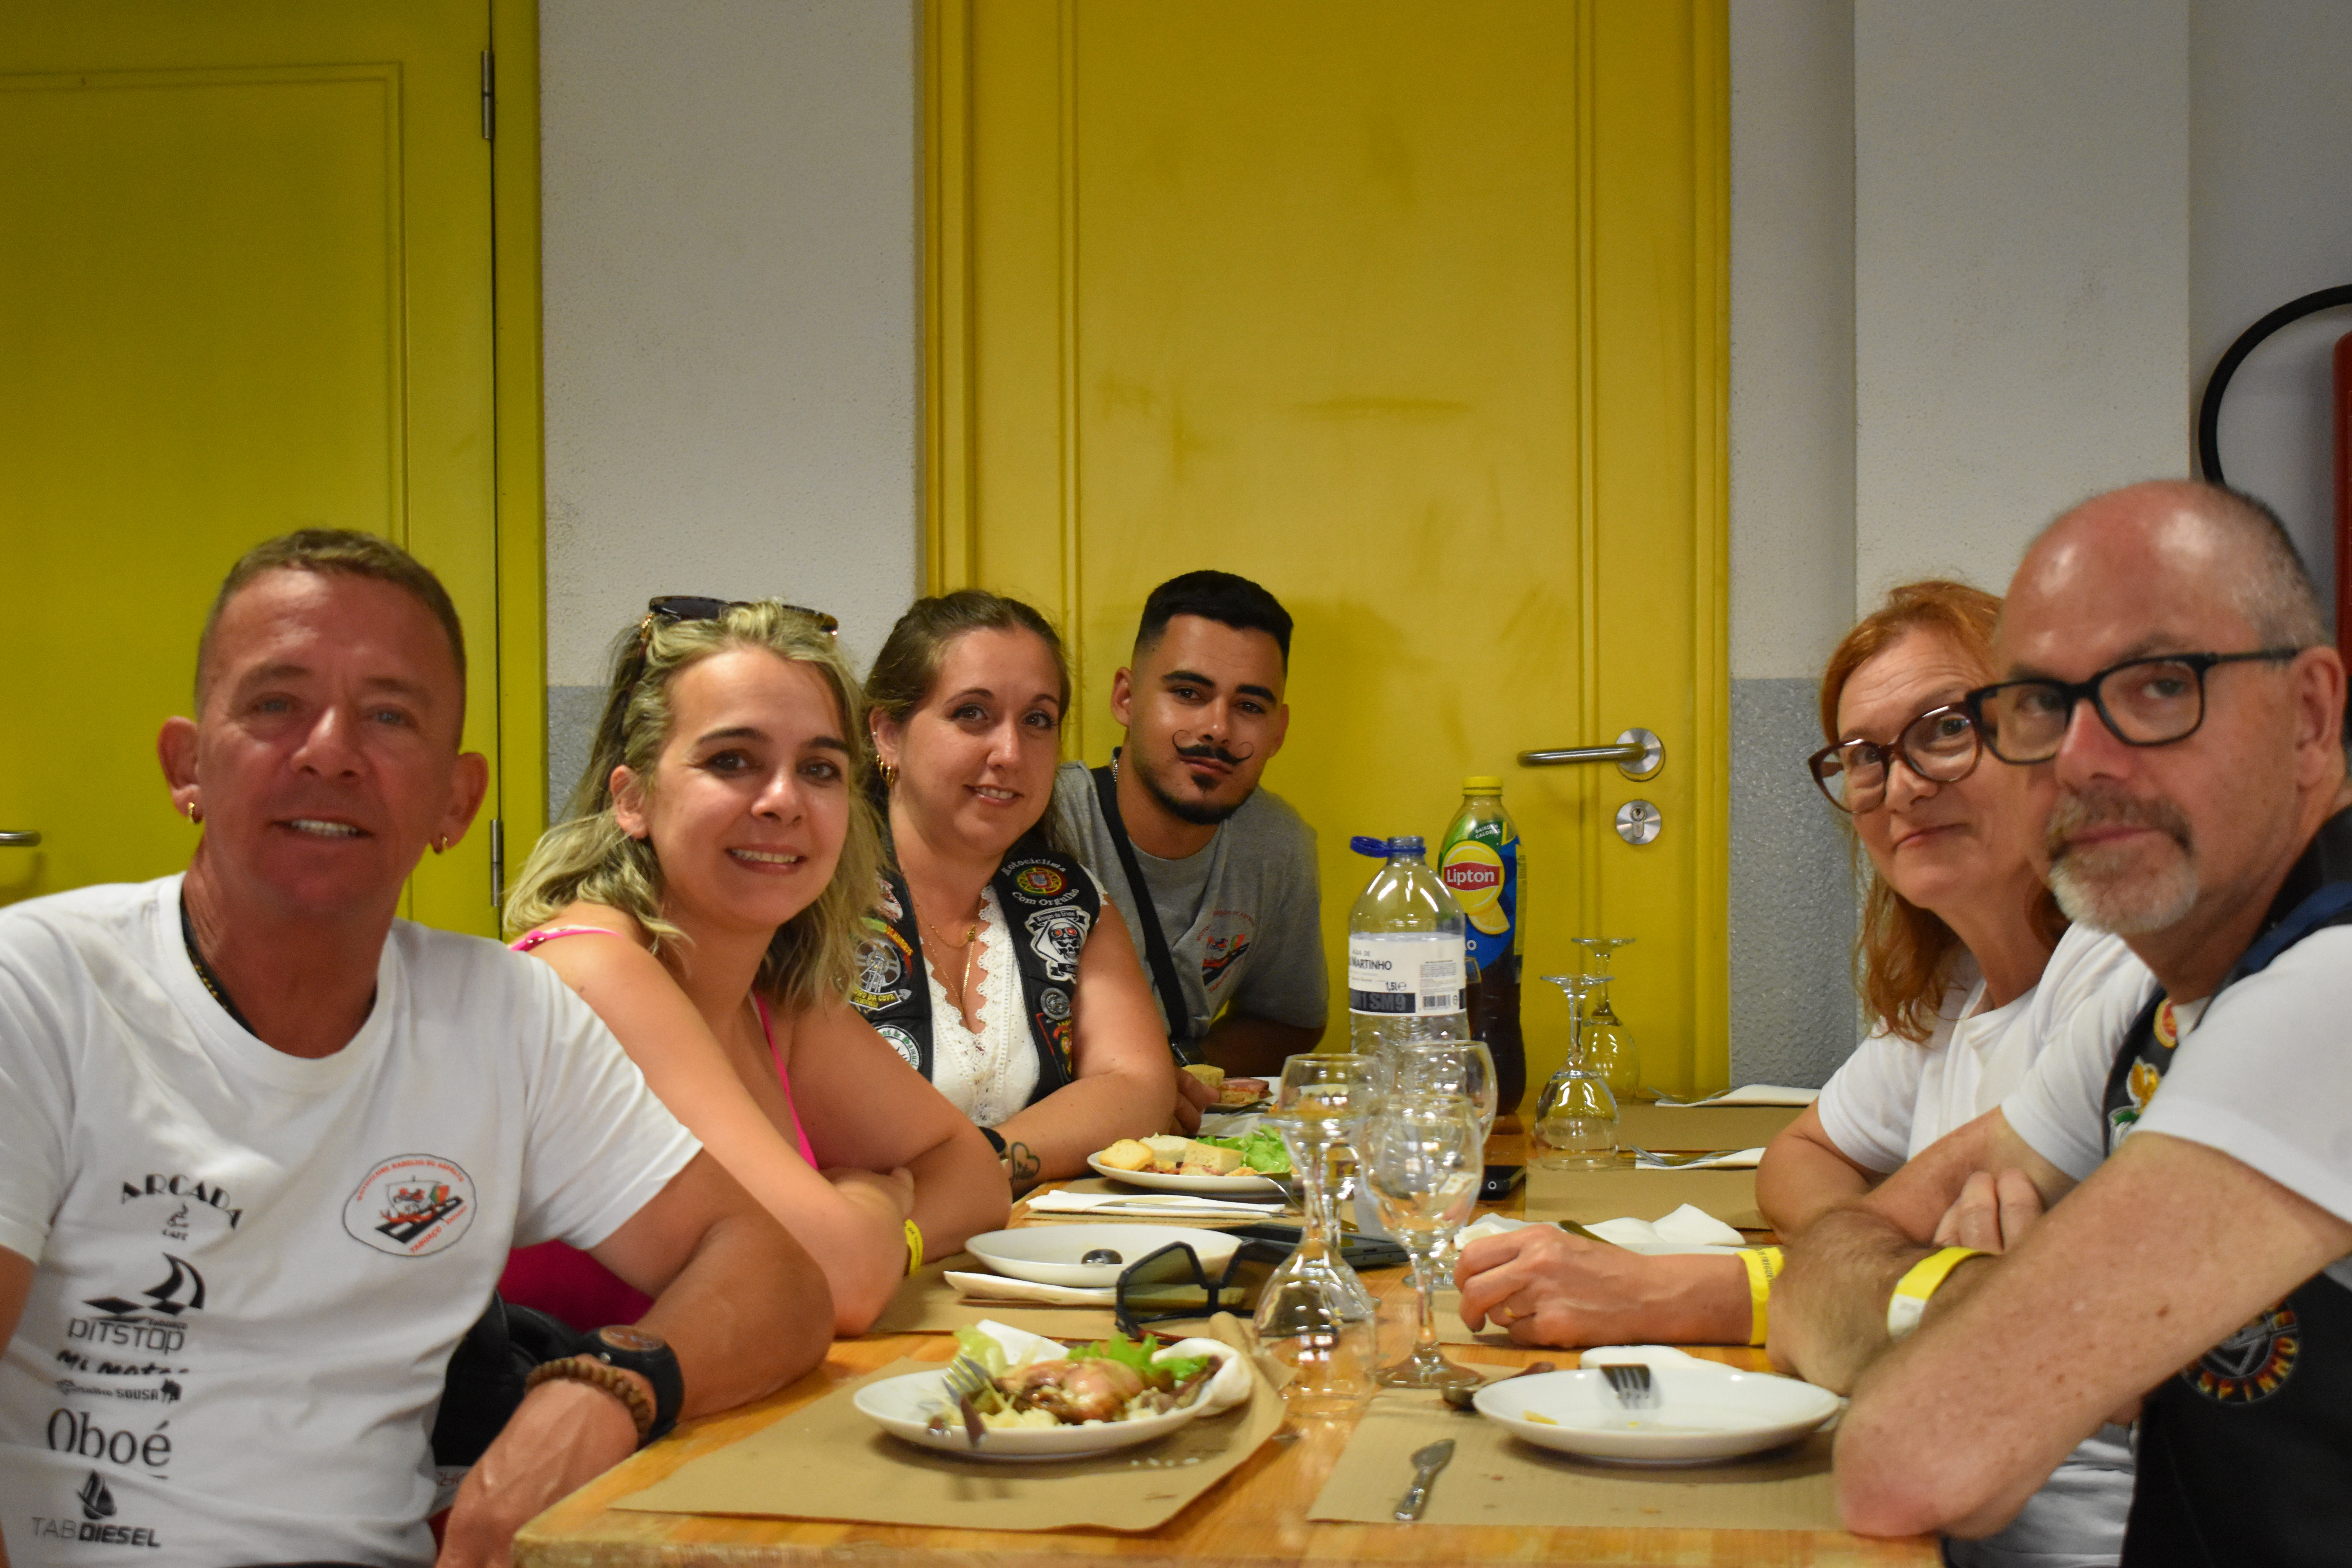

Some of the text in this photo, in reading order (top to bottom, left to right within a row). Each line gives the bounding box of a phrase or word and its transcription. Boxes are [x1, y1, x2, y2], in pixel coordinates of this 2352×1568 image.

[1446, 869, 1495, 886] Lipton
[1012, 889, 1079, 906] Com Orgulho
[1352, 956, 1392, 971] MARTINHO
[120, 1174, 243, 1230] ARCADA
[48, 1407, 171, 1467] Oboé
